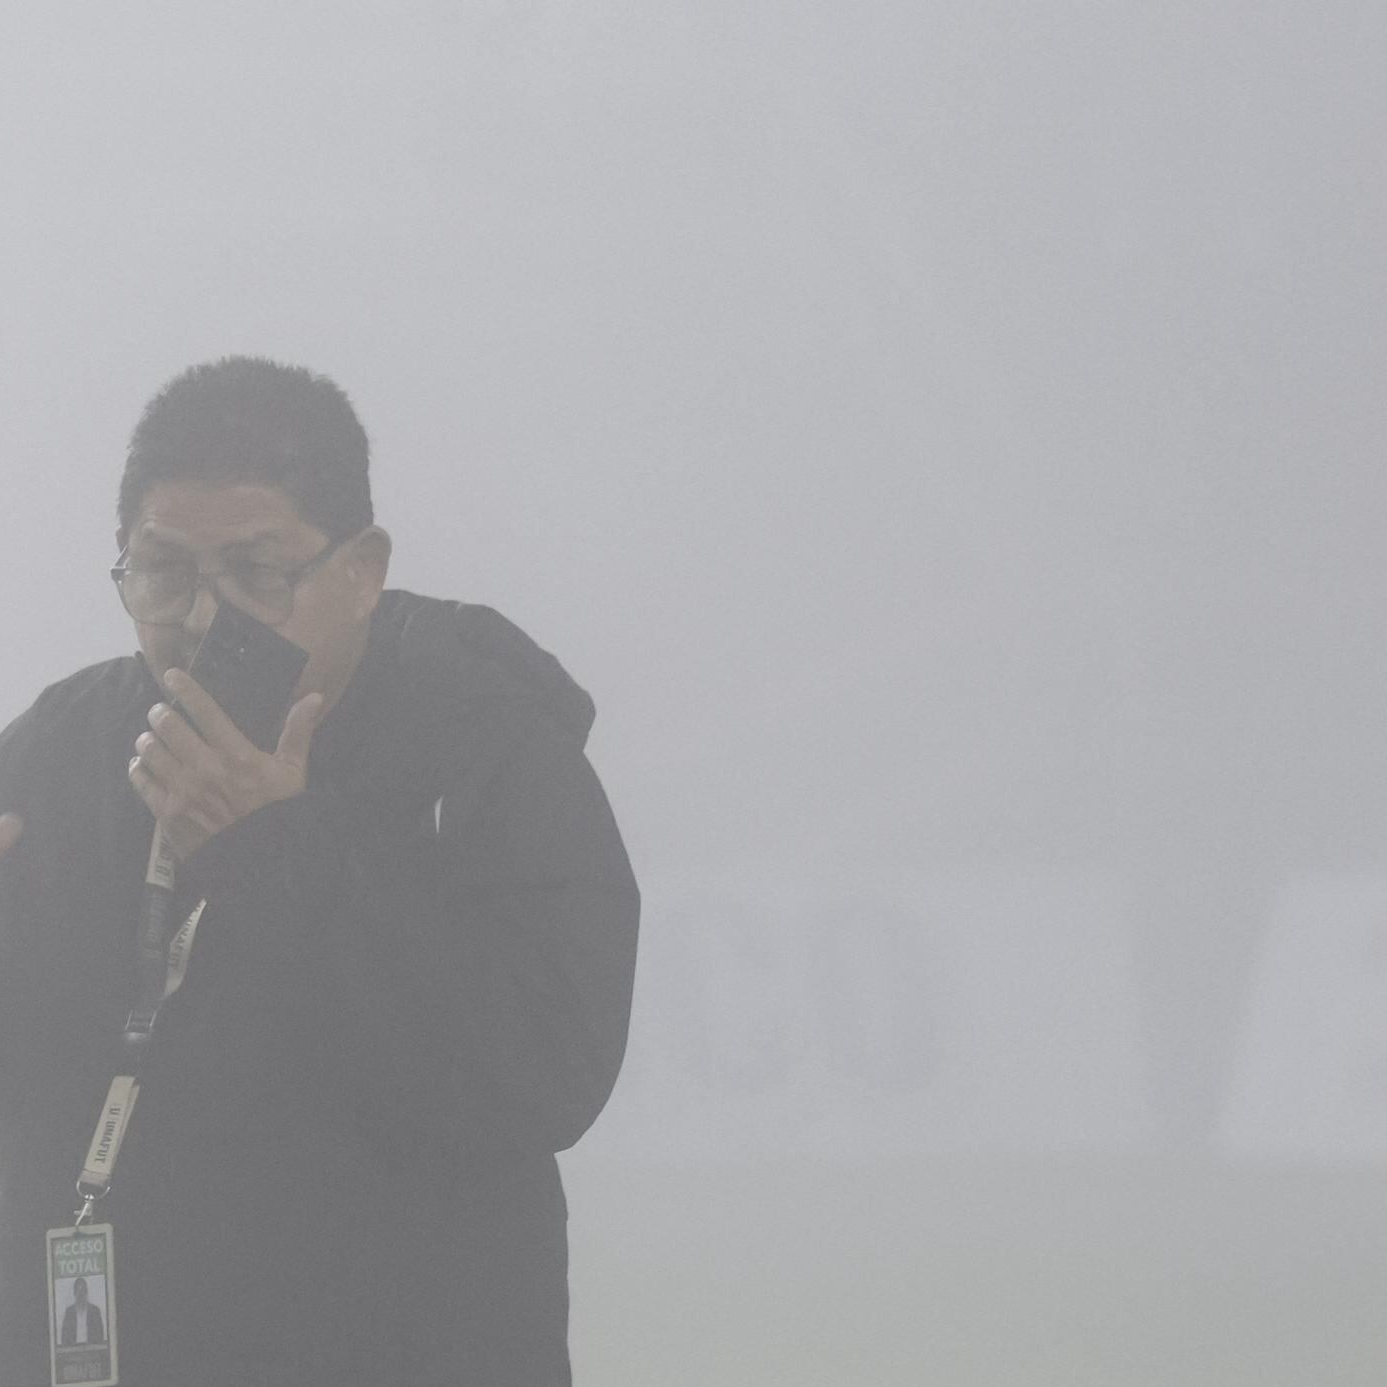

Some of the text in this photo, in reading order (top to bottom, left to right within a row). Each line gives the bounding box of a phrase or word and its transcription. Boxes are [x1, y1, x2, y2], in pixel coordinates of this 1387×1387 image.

[94, 1120, 117, 1164] UNAFUT
[55, 1238, 104, 1257] ACCESO
[58, 1257, 101, 1275] TOTAL
